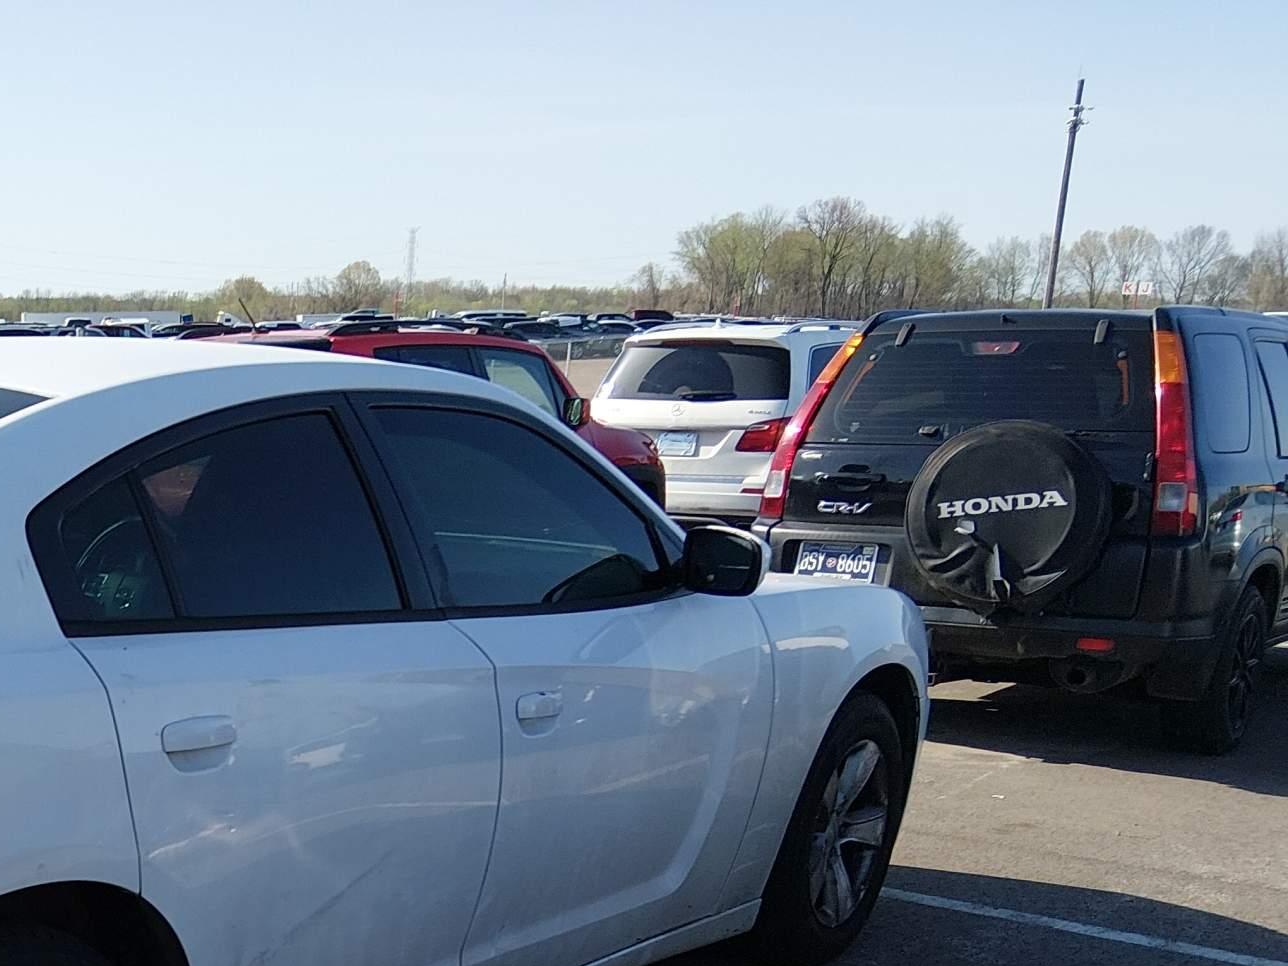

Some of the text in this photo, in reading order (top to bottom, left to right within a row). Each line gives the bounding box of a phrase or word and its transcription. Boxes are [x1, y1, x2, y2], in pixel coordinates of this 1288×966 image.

[1123, 283, 1135, 293] K
[817, 500, 873, 514] CR-V
[937, 490, 1069, 519] HONDA
[836, 553, 871, 574] 8605
